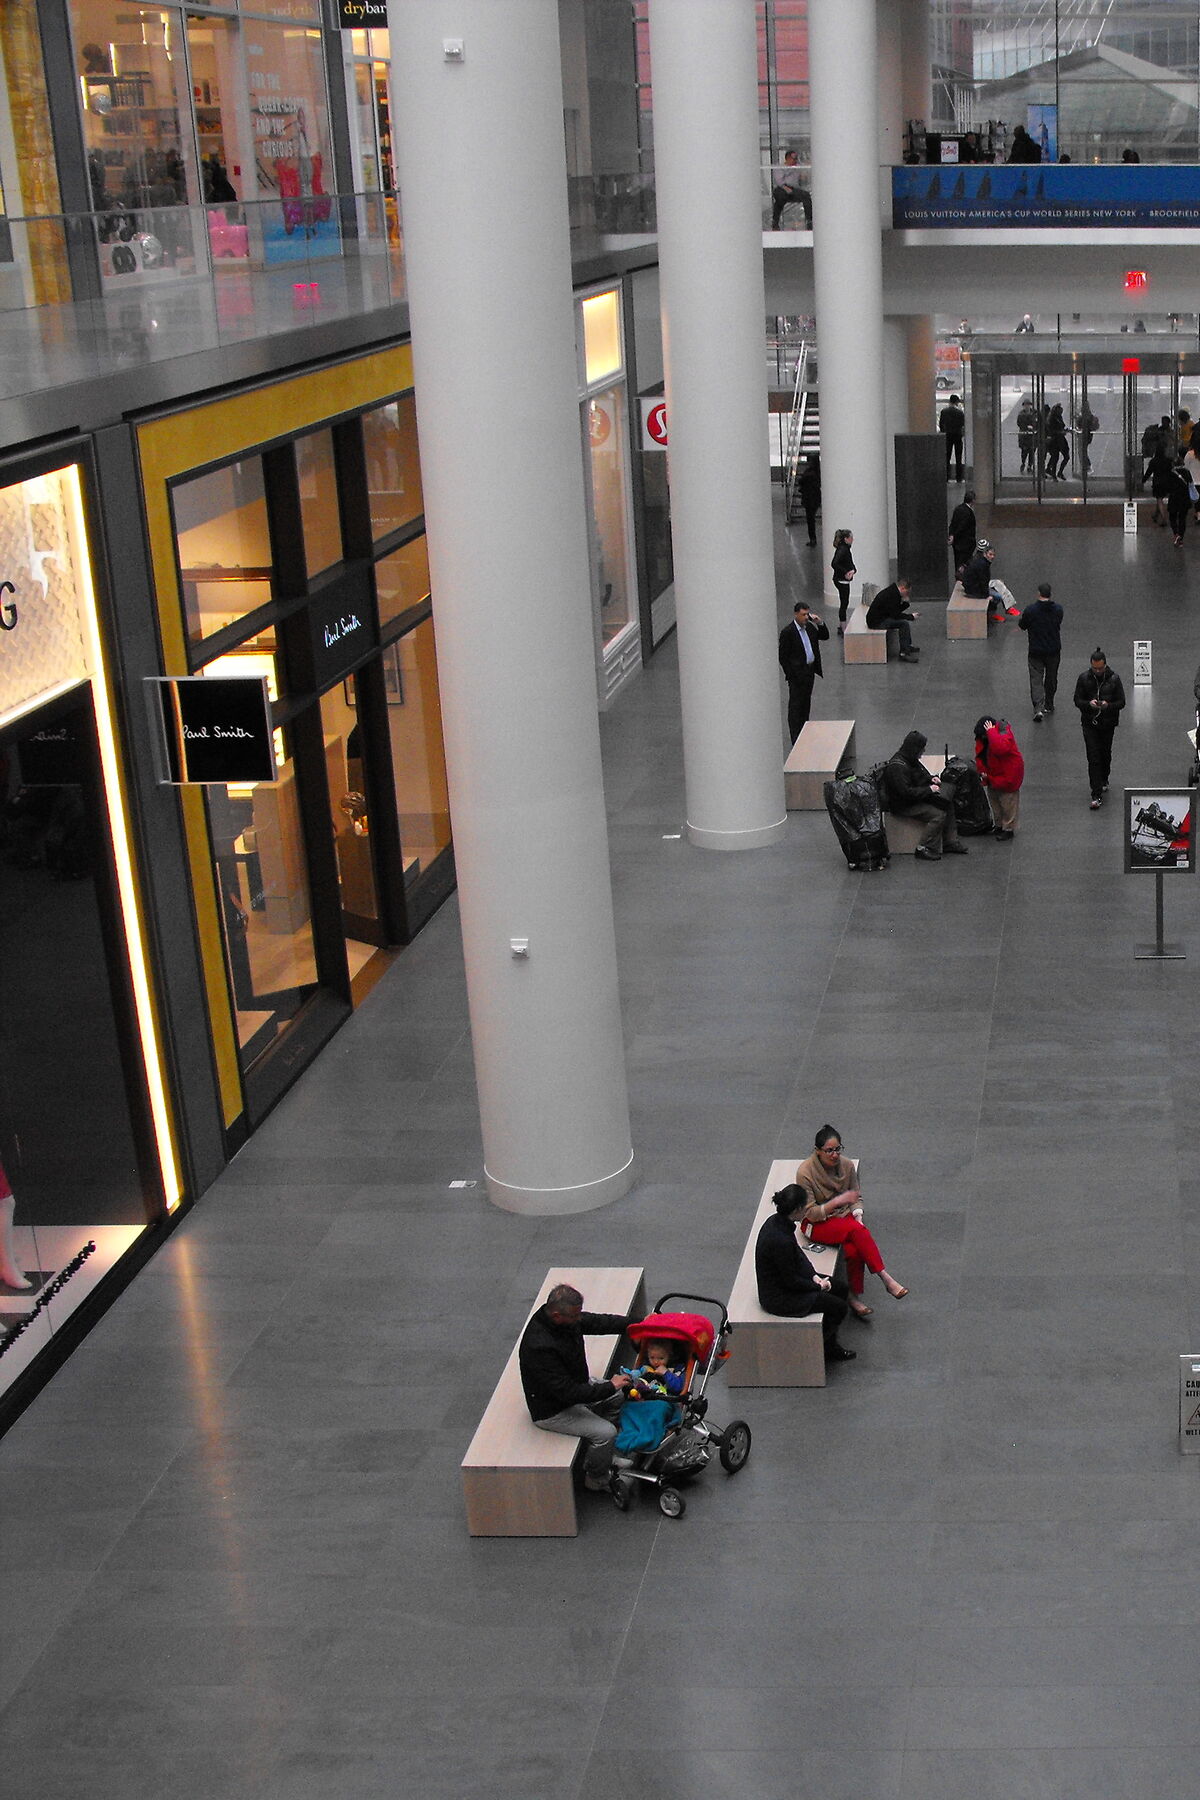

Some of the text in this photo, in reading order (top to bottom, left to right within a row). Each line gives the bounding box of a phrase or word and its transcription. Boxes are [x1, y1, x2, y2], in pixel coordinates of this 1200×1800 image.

[344, 1, 387, 19] drybar
[904, 210, 929, 218] LOUIS
[931, 210, 966, 218] VUITTON
[968, 210, 1013, 218] AMERICA'S
[1014, 210, 1031, 218] CUP
[1033, 210, 1062, 218] WORLD
[1064, 210, 1091, 218] SERIES
[1149, 210, 1199, 218] BROOKFIELD
[0, 580, 18, 631] G
[324, 614, 362, 648] Paul Smith
[182, 724, 255, 739] Paul Smith
[1185, 1428, 1198, 1436] WET
